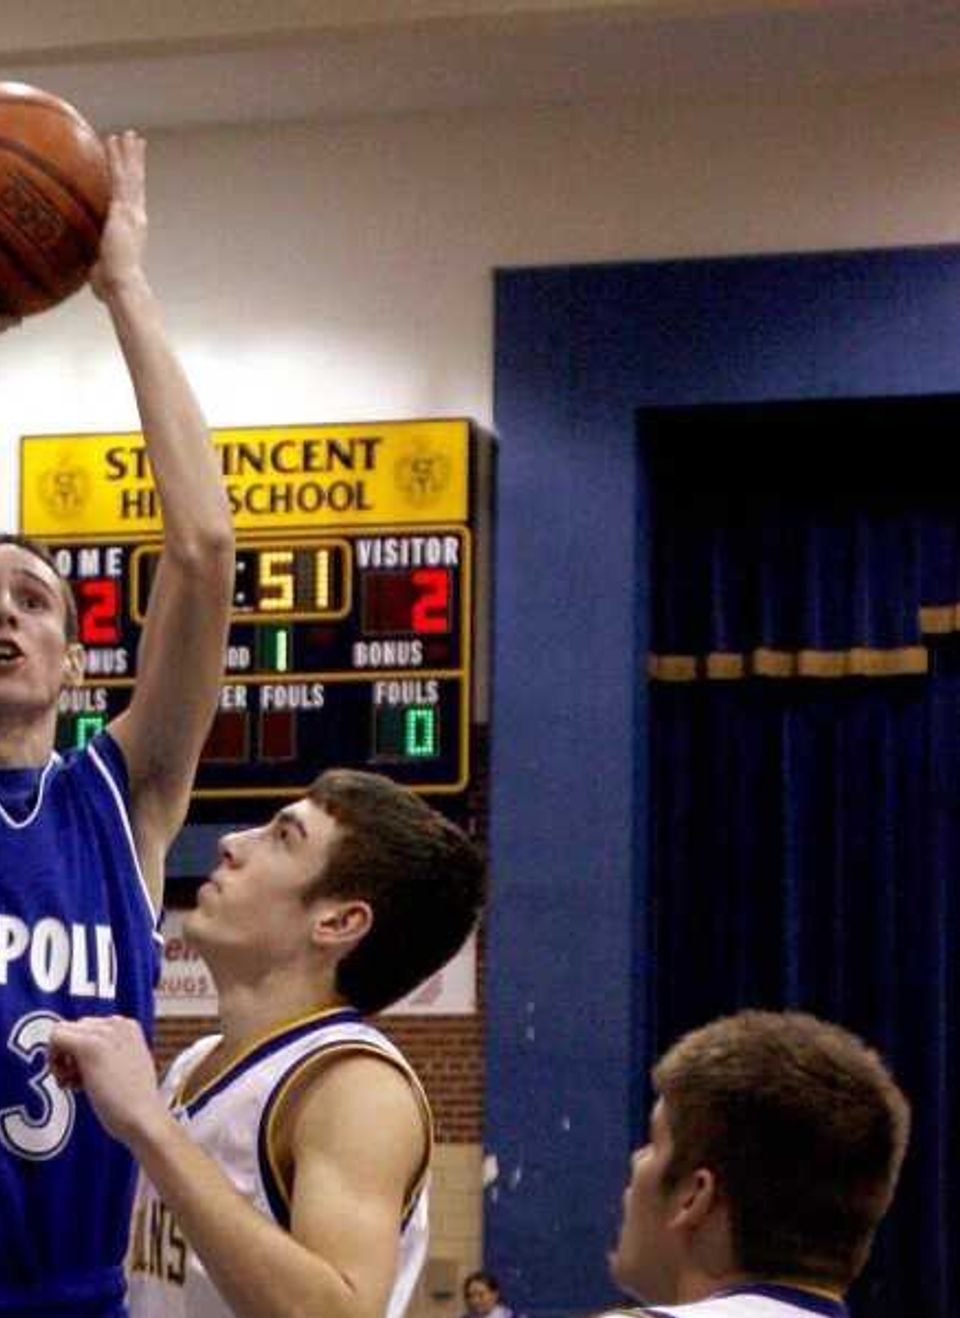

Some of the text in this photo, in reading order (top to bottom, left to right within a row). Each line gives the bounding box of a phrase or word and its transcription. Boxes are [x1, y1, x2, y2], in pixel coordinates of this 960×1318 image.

[216, 438, 381, 477] INCENT
[120, 487, 158, 520] HI
[226, 480, 374, 517] SCHOOL
[56, 547, 124, 579] OME
[356, 537, 459, 568] VISITOR
[81, 579, 118, 644] 2
[412, 569, 449, 633] 2
[276, 629, 287, 672] 1
[353, 640, 424, 668] BONUS
[58, 688, 108, 714] OULS
[260, 684, 325, 709] FOULS
[374, 681, 439, 705] FOULS
[406, 710, 435, 757] 0
